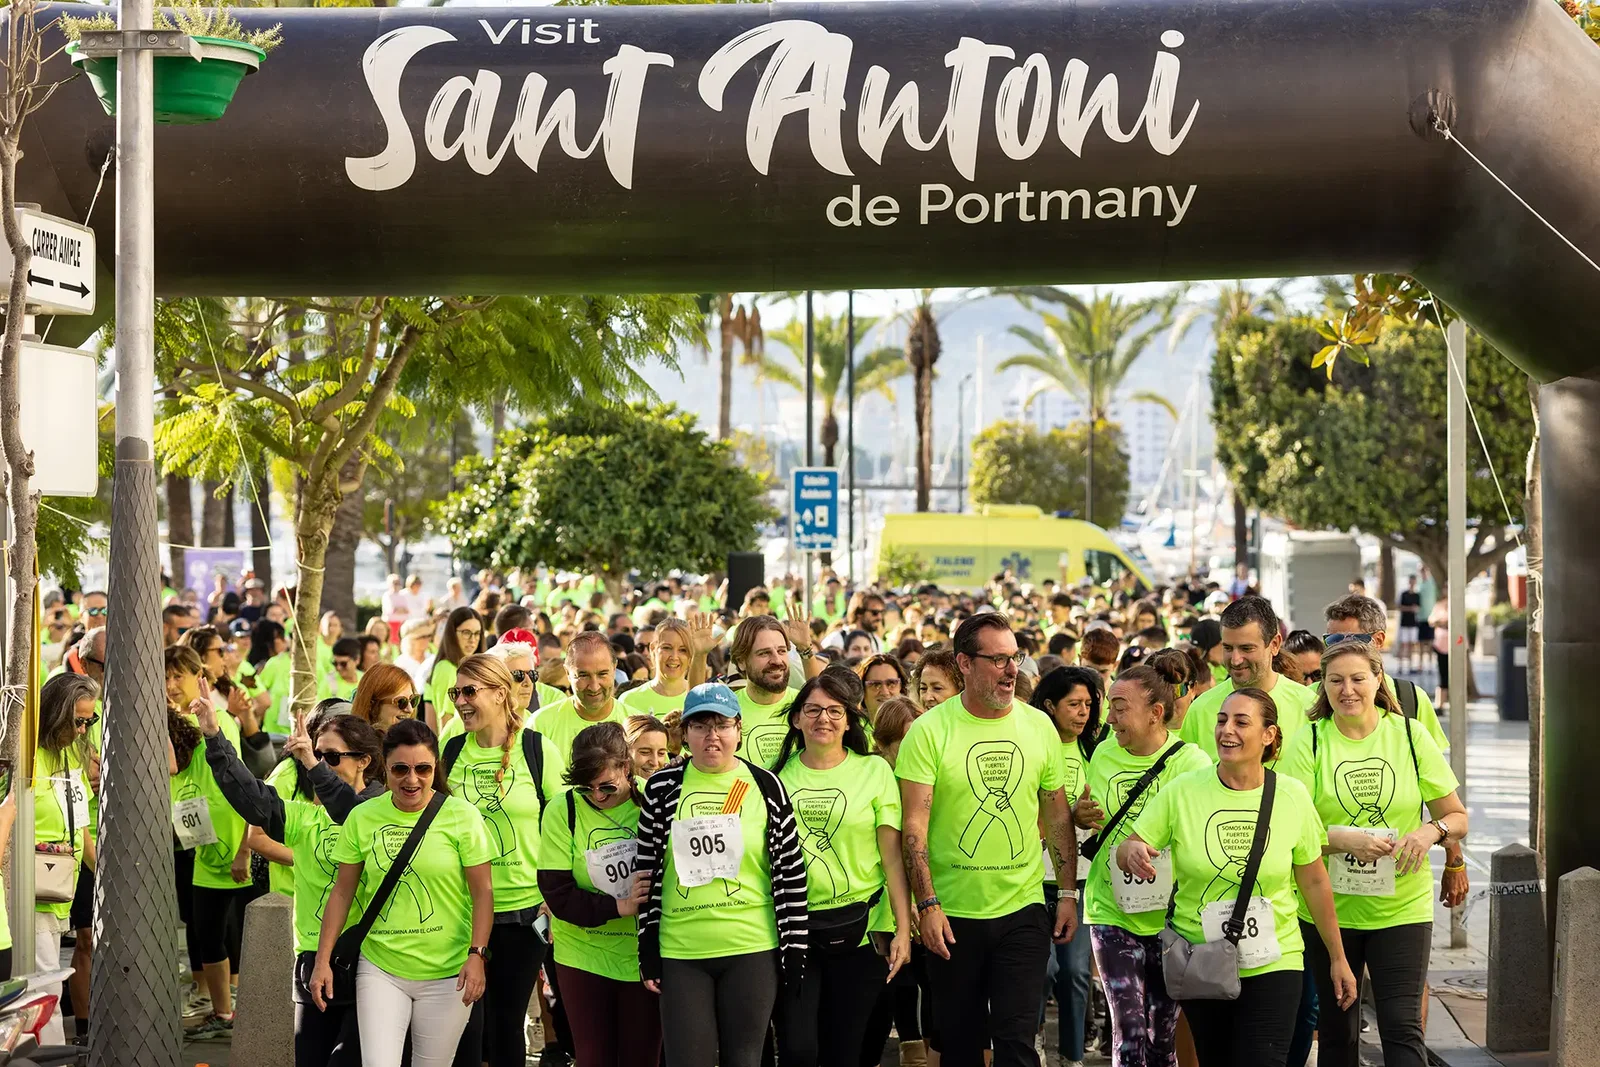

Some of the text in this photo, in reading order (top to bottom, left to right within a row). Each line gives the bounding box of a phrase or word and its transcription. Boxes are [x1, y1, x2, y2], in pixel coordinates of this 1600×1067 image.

[478, 18, 600, 45] Visit
[345, 19, 1200, 191] Sant Antoni
[825, 181, 1198, 227] de Portmany
[32, 227, 81, 268] CARRER AMPLE
[182, 812, 202, 829] 601
[689, 833, 726, 857] 905
[605, 855, 637, 883] 904
